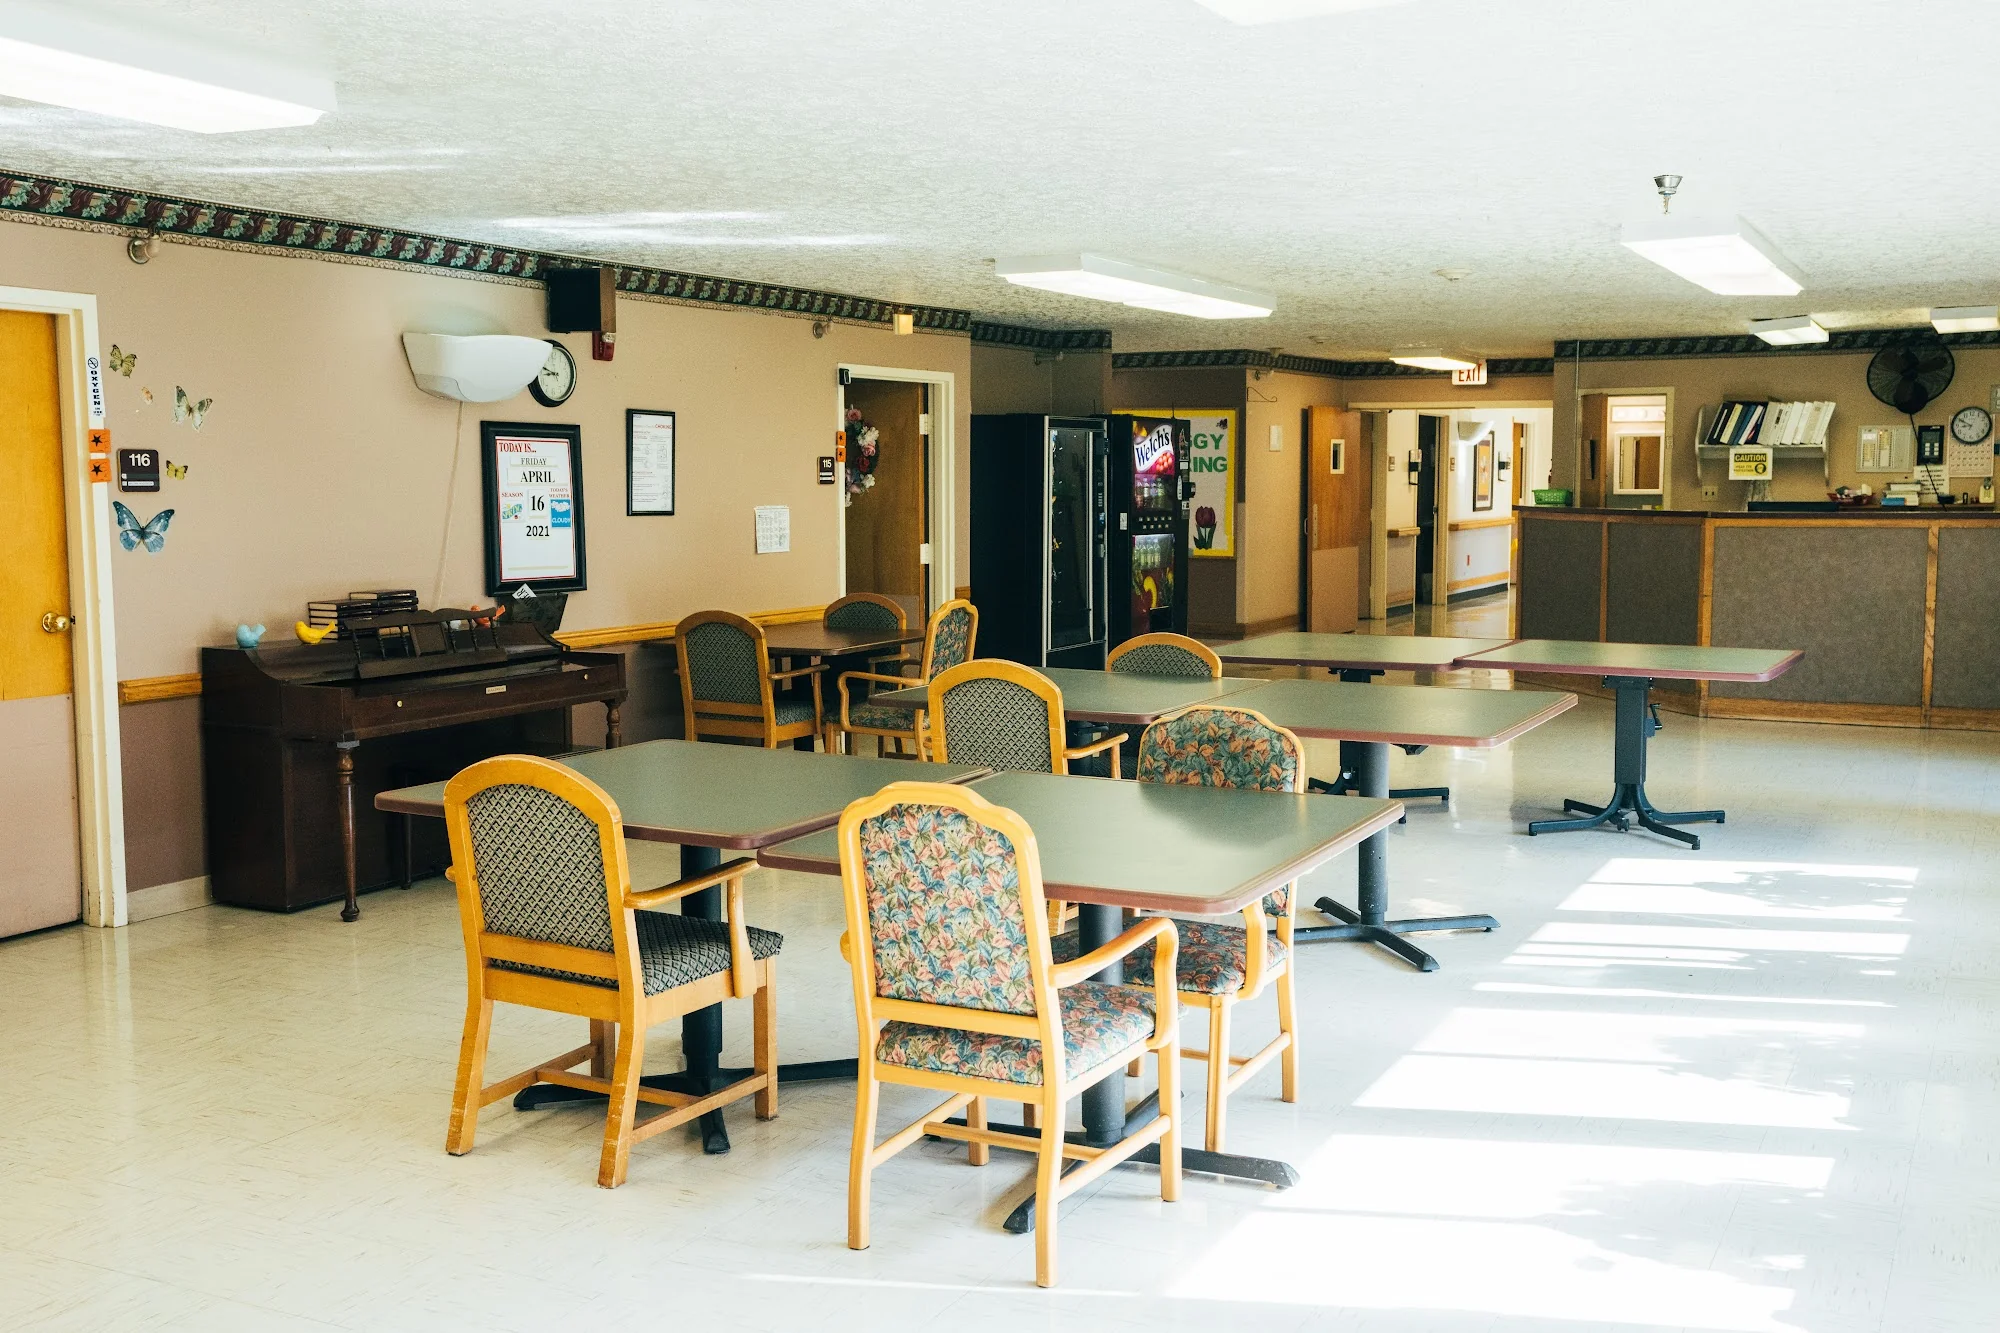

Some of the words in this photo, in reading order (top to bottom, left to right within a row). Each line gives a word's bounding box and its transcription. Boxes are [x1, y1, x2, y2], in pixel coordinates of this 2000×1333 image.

[1458, 363, 1482, 382] EXIT
[90, 370, 101, 406] OXYGEN
[499, 442, 523, 453] TODAY
[1135, 428, 1170, 467] Welch's
[128, 453, 151, 467] 116
[520, 457, 547, 466] FRIDAY
[822, 459, 832, 468] 115
[1735, 454, 1766, 462] CAUTION
[520, 470, 556, 483] APRIL
[531, 495, 545, 512] 16
[526, 525, 550, 537] 2021
